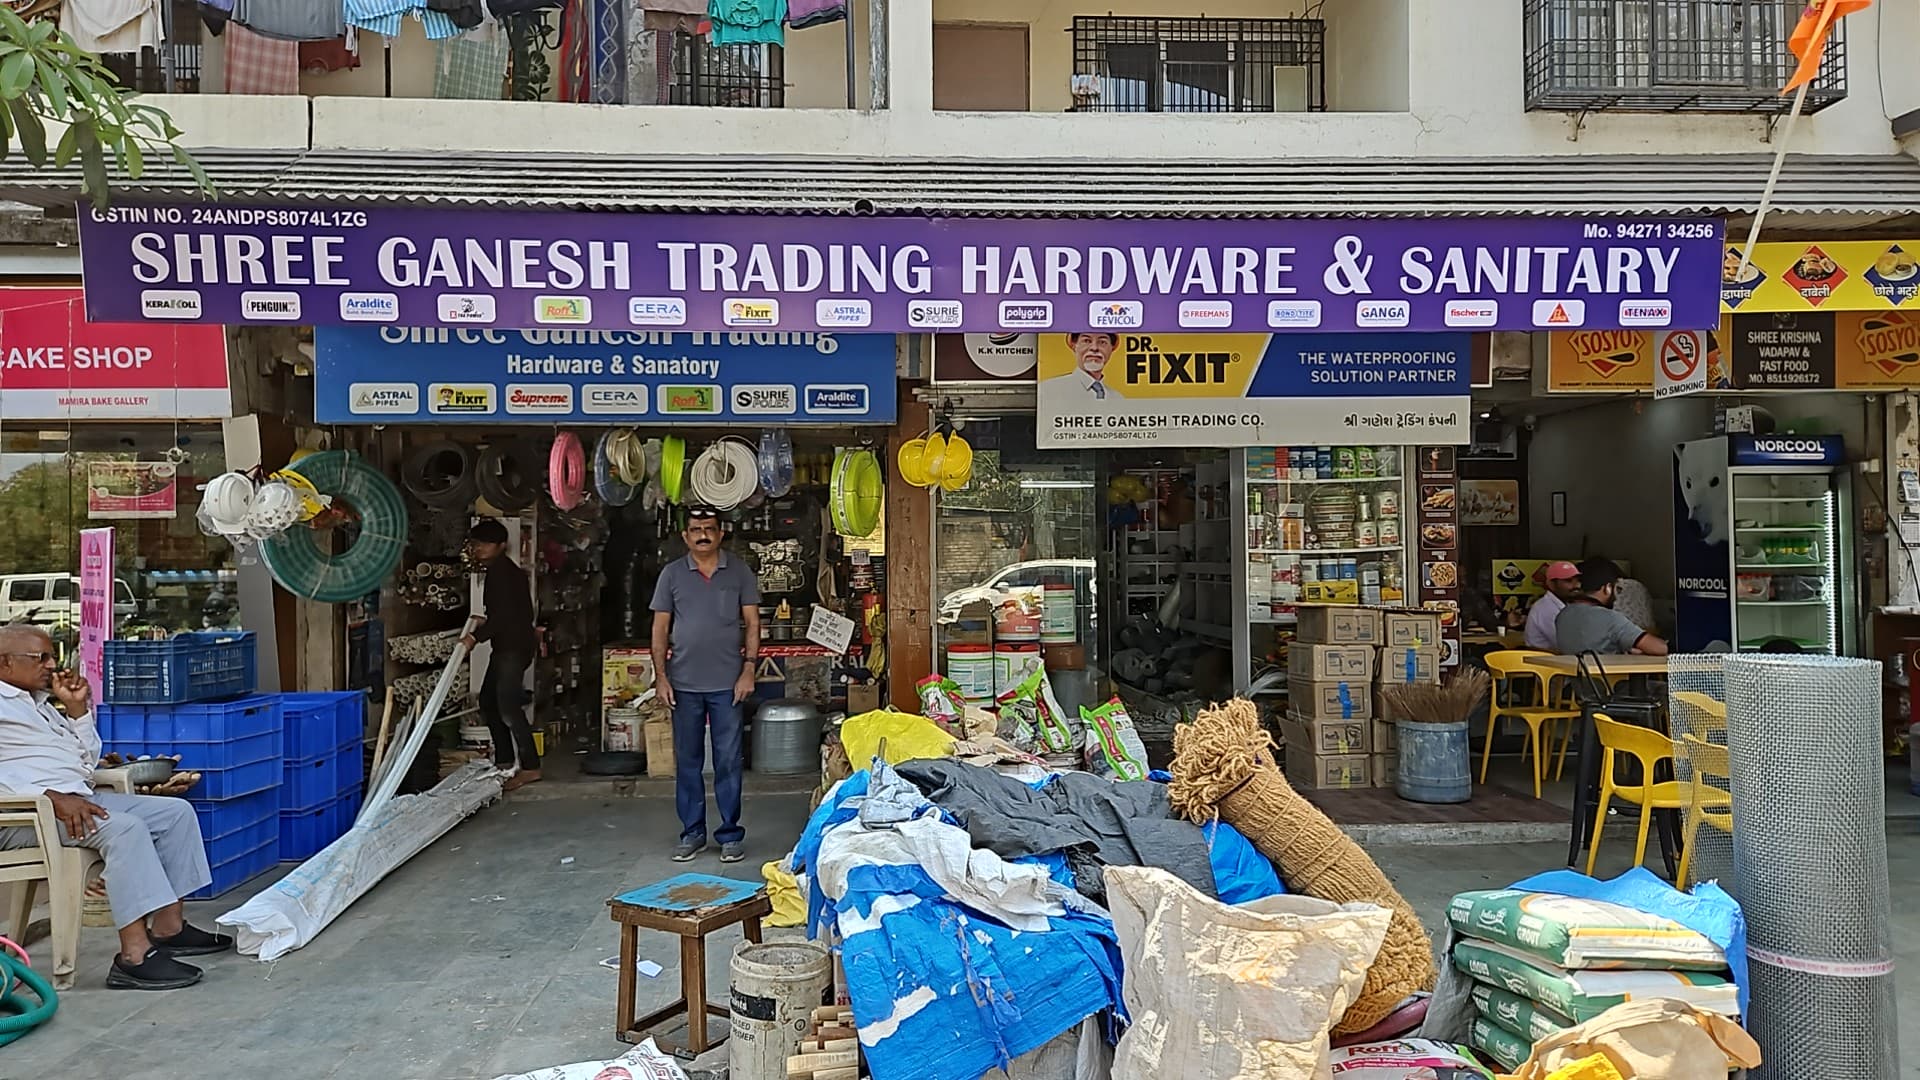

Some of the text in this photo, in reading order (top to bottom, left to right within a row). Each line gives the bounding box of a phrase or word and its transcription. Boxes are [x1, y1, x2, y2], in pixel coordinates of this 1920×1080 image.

[90, 208, 367, 228] GSTIN NO. 24ANDPS8074L1ZG
[1583, 223, 1714, 239] Mo. 94271 34256
[130, 231, 1681, 295] SHREE GANESH TRADING HARDWARE & SANITARY
[1800, 283, 1831, 298] दावेली
[346, 298, 393, 309] Araldite
[633, 303, 682, 314] CERA
[833, 306, 866, 315] ASTRAL
[925, 306, 959, 316] SURIE
[1006, 307, 1046, 320] polygrip
[1190, 310, 1230, 319] FREEMANS
[1361, 306, 1406, 318] GANGA
[1450, 308, 1479, 317] fischer
[1627, 307, 1664, 317] TENAX
[1097, 315, 1136, 325] FEVICOL
[1579, 329, 1634, 357] SOSYO
[1748, 331, 1822, 344] SHREE KRISHNA
[1866, 325, 1918, 356] SOSYO
[1126, 336, 1159, 353] DR.
[995, 347, 1034, 355] KITCHEN
[1759, 346, 1811, 358] VADAPAV &
[72, 346, 153, 370] SHOP
[1298, 351, 1457, 365] THE WATERPROOFING
[506, 353, 720, 379] Hardware & Sanatory
[1759, 360, 1810, 372] FAST FOOD
[1310, 369, 1457, 383] SOLUTION PARTNER
[1766, 373, 1820, 384] 8511926172
[1655, 380, 1705, 397] NO SMOKING
[58, 396, 149, 406] MAMIRA BAKE GALLERY
[372, 390, 413, 400] ASTRAL
[510, 389, 568, 406] Supreme
[591, 390, 638, 401] CERA
[752, 390, 789, 400] SURIE
[816, 391, 857, 402] Araldite
[375, 399, 400, 407] PIPES
[1054, 414, 1265, 428] SHREE GANESH TRADING CO.
[1343, 411, 1457, 429] શ્રી ગણેશ ટ્રેડિંગ કંપની
[1754, 440, 1825, 452] NORCOOL
[1678, 577, 1728, 591] NORCOOL
[1347, 1044, 1400, 1057] Roff
